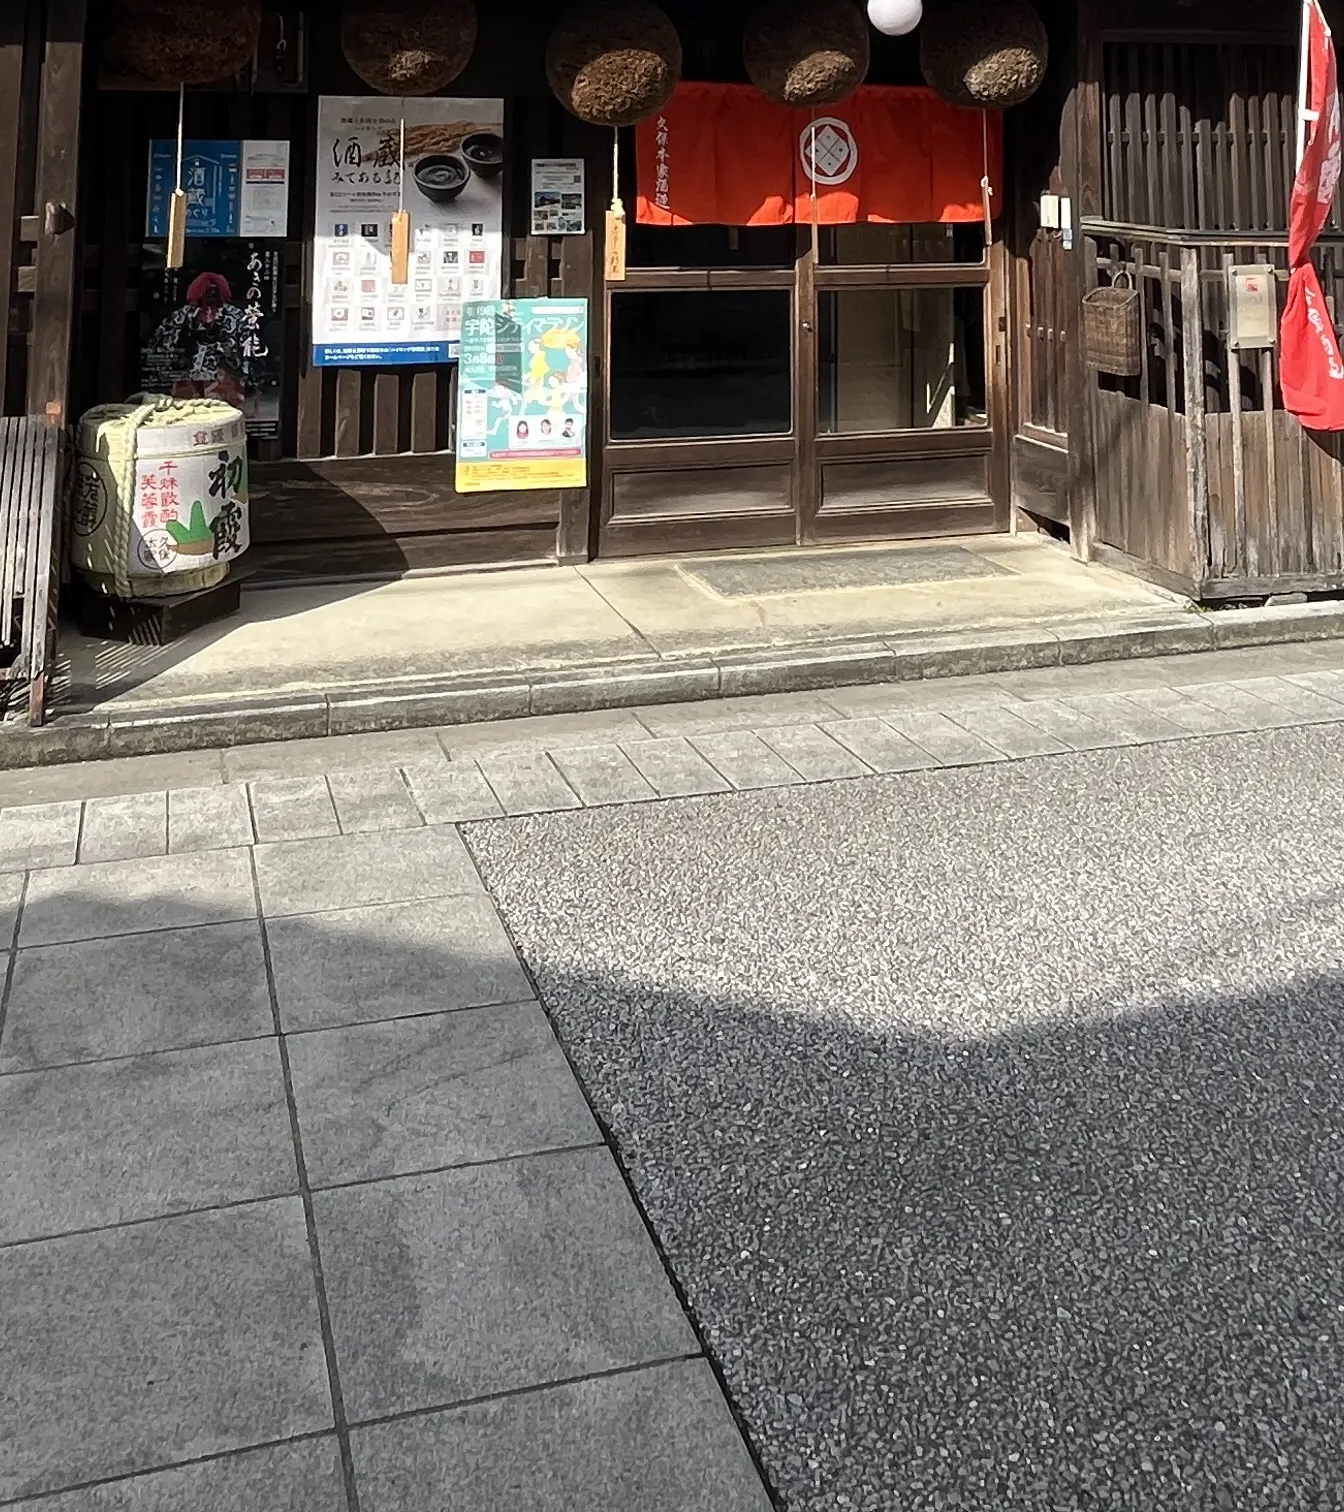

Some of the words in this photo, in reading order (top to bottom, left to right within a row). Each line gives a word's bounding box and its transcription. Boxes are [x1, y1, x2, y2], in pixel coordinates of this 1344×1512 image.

[333, 134, 405, 171] 酒蔵
[655, 115, 670, 210] 久保本家酒造
[464, 312, 585, 337] 宇陀シティマラソン
[208, 450, 244, 561] 初霞
